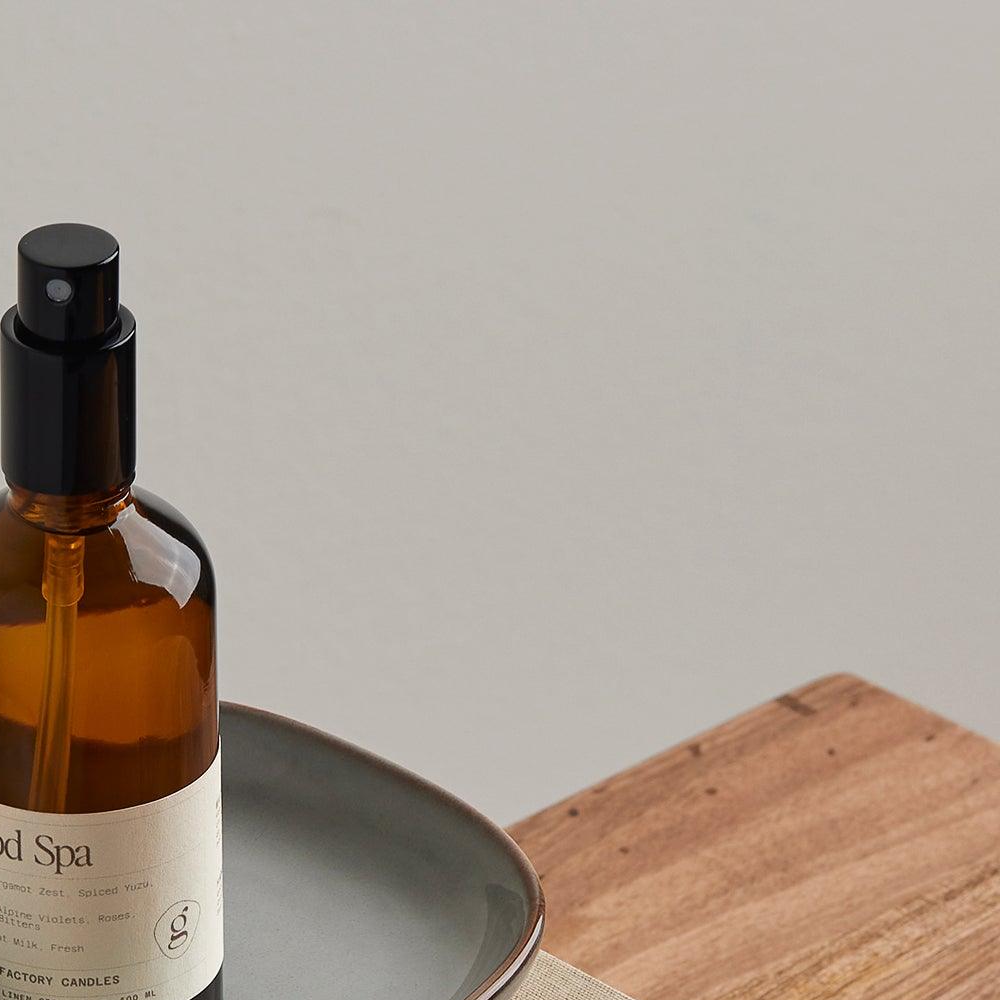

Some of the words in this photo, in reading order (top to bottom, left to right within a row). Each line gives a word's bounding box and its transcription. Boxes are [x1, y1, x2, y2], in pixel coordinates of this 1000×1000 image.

[34, 834, 93, 874] Spa
[51, 944, 84, 952] Fresh
[62, 975, 120, 987] CANDLES
[144, 989, 156, 998] ML
